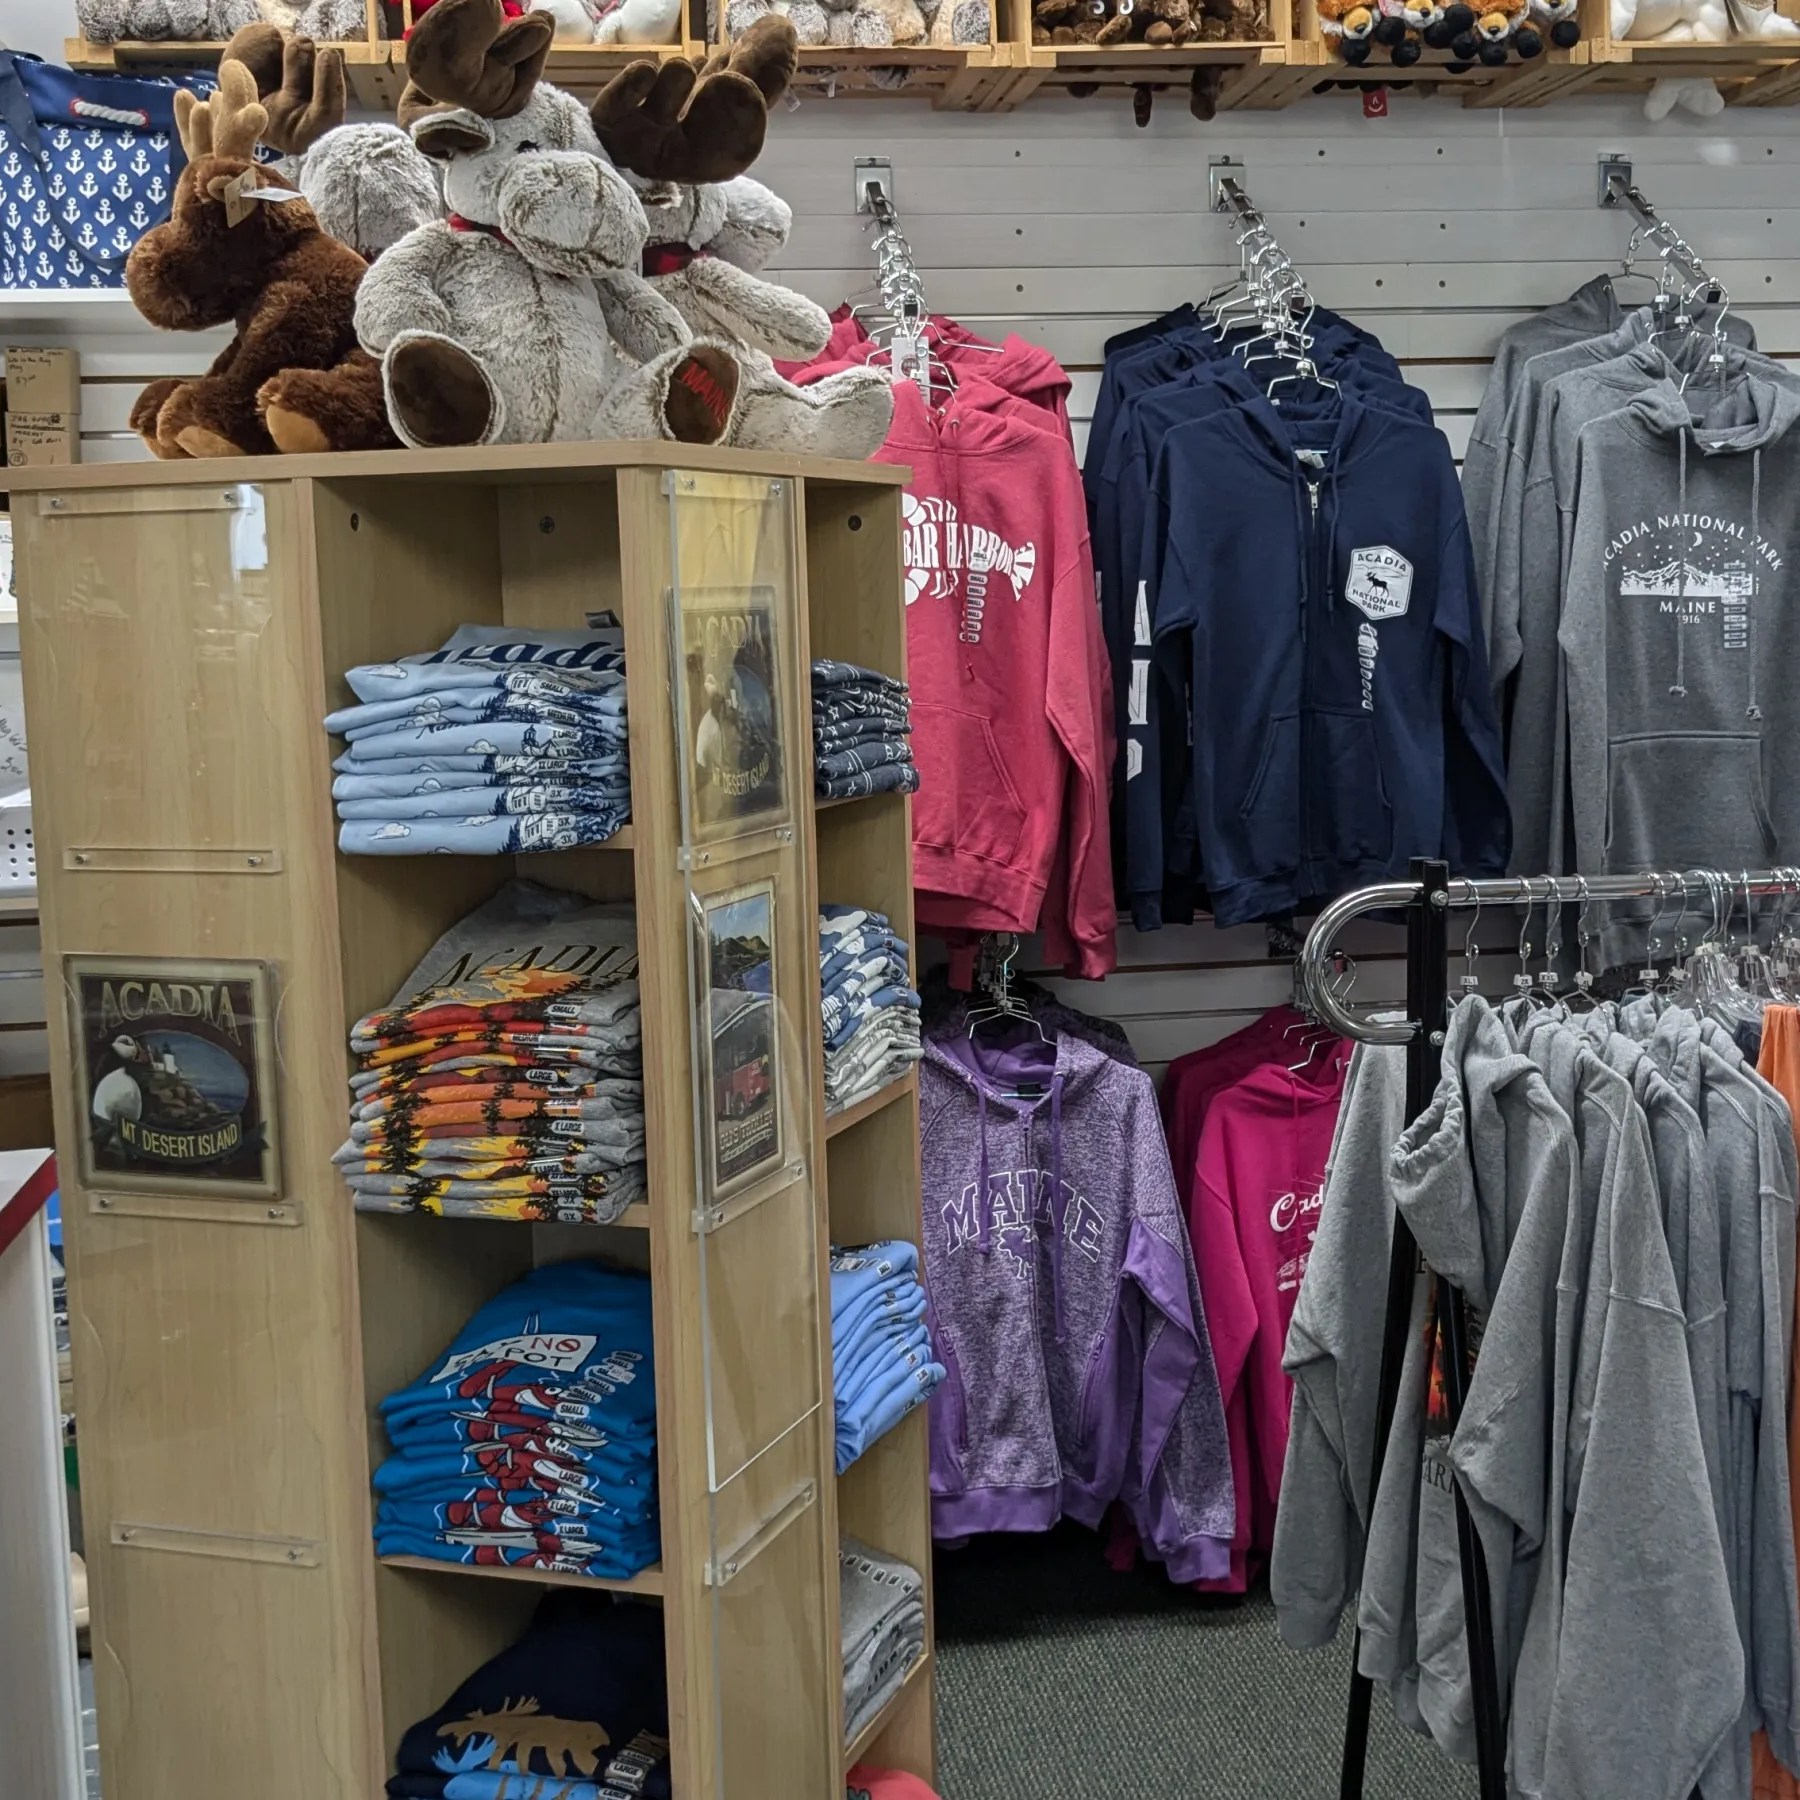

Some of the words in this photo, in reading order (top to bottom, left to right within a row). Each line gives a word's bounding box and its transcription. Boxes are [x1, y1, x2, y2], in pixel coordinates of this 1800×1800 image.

[1657, 513, 1746, 541] NATIONAL
[903, 522, 940, 569] BAR
[1357, 553, 1408, 573] ACADIA
[1352, 588, 1401, 609] NATIONAL
[1361, 599, 1387, 614] PARK
[1659, 601, 1716, 614] MAINE
[695, 614, 768, 674] ACADIA
[539, 681, 564, 694] SMALL
[722, 765, 750, 797] DESERT
[750, 751, 770, 789] ISLAND
[550, 789, 562, 798] 3X
[557, 816, 571, 827] 3X
[560, 834, 572, 845] 3X
[98, 981, 242, 1047] ACADIA
[551, 1004, 576, 1014] SMALL
[529, 1070, 553, 1080] LARGE
[560, 1122, 583, 1132] LARGE
[141, 1129, 195, 1160] DESERT
[197, 1122, 239, 1159] ISLAND
[562, 1212, 576, 1221] 3X
[940, 1168, 1104, 1263] MAINE
[530, 1336, 581, 1353] NO
[503, 1347, 573, 1367] POT
[560, 1403, 585, 1416] SMALL
[558, 1469, 585, 1486] LARGE
[555, 1501, 576, 1514] LARGE
[565, 1525, 585, 1535] LARGE
[613, 1762, 639, 1777] LARGE
[602, 1788, 627, 1800] LARGE
